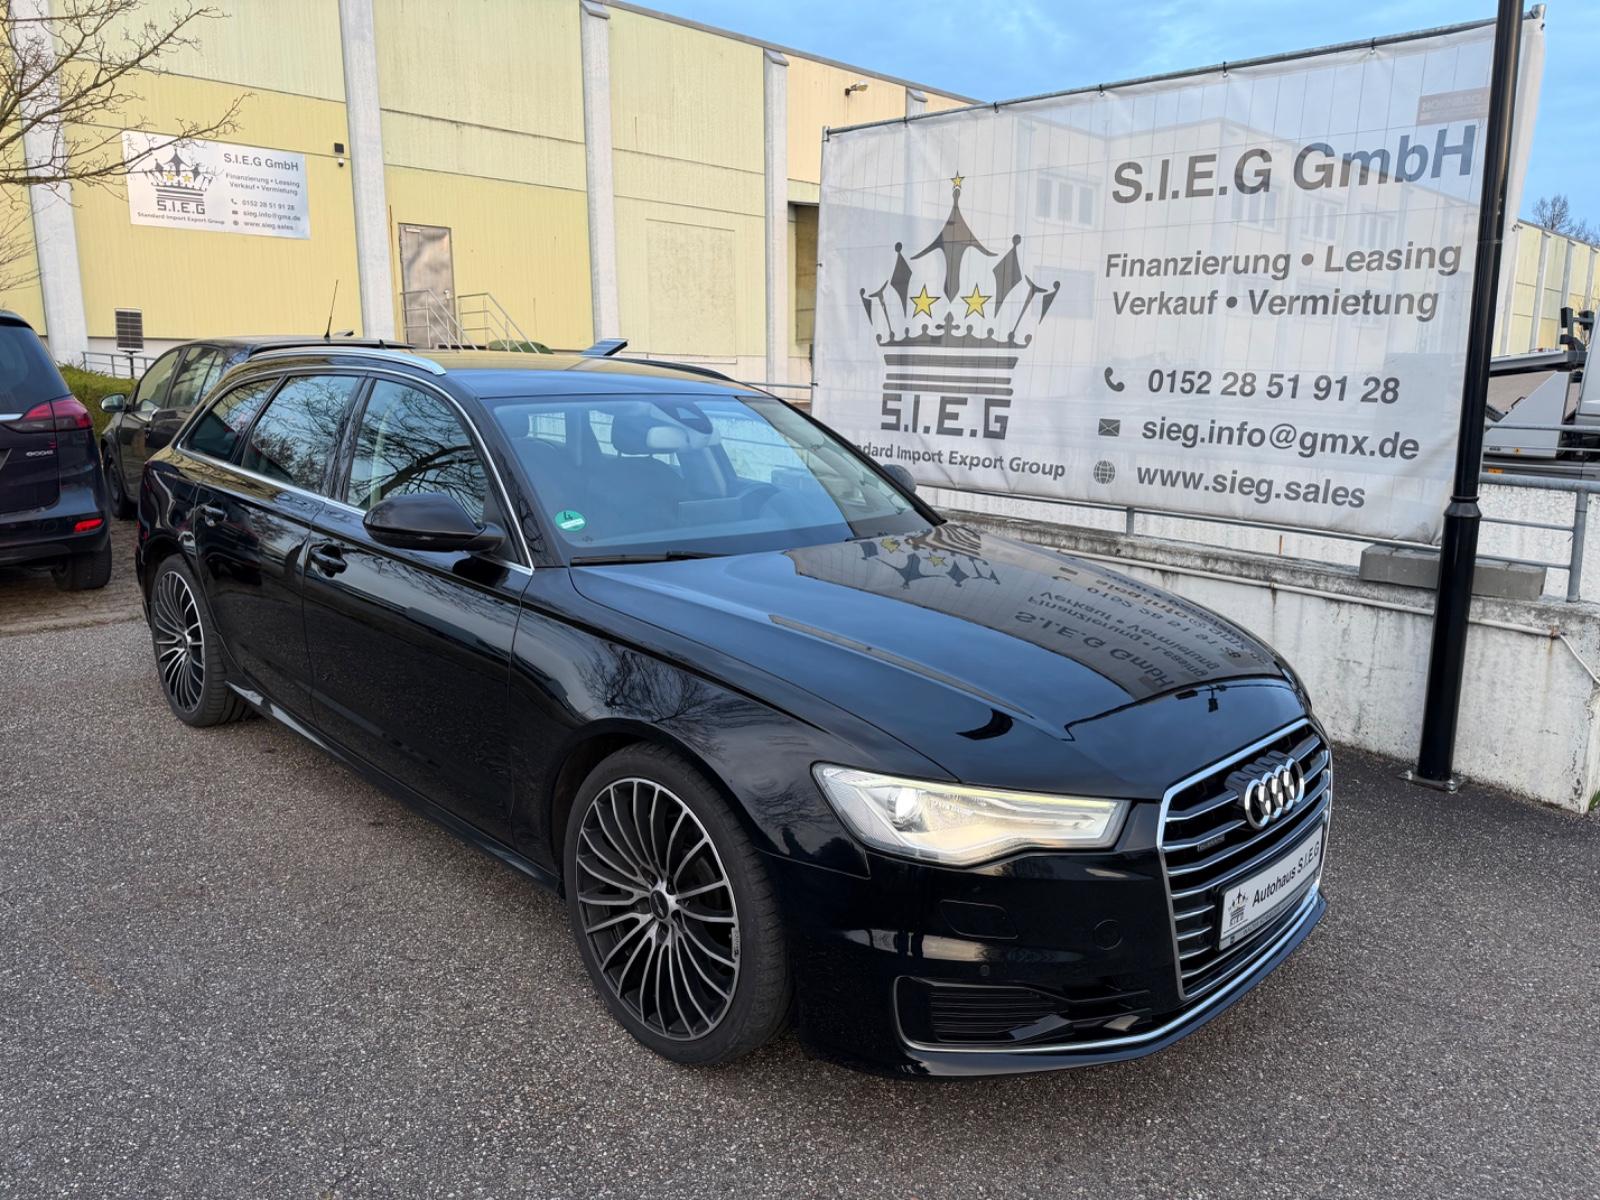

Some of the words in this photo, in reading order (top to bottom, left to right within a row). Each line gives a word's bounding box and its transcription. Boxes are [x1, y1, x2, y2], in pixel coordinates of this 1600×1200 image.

[223, 153, 262, 167] S.I.E.G
[264, 158, 299, 172] GmbH
[1112, 148, 1273, 204] S.I.E.G
[1293, 124, 1476, 191] GmbH
[229, 181, 255, 190] Verkauf
[261, 185, 298, 196] Vermietung
[275, 178, 300, 189] Leasing
[157, 200, 206, 215] S.I.E.G
[1105, 249, 1292, 280] Finanzierung
[1325, 241, 1462, 277] Leasing
[1112, 289, 1219, 317] Verkauf
[1248, 288, 1440, 322] Vermietung
[1148, 368, 1212, 395] 0152
[1220, 371, 1258, 398] 28
[1266, 373, 1301, 400] 51
[1313, 375, 1349, 402] 91
[1360, 376, 1401, 404] 28
[880, 392, 1012, 440] S.I.E.G
[1141, 416, 1420, 460] sieg.info@gmx.de
[896, 446, 944, 466] Import
[948, 450, 1005, 472] Export
[1008, 456, 1067, 482] Group
[1136, 465, 1367, 508] www.sieg.sales
[1252, 866, 1297, 908] Autohaus
